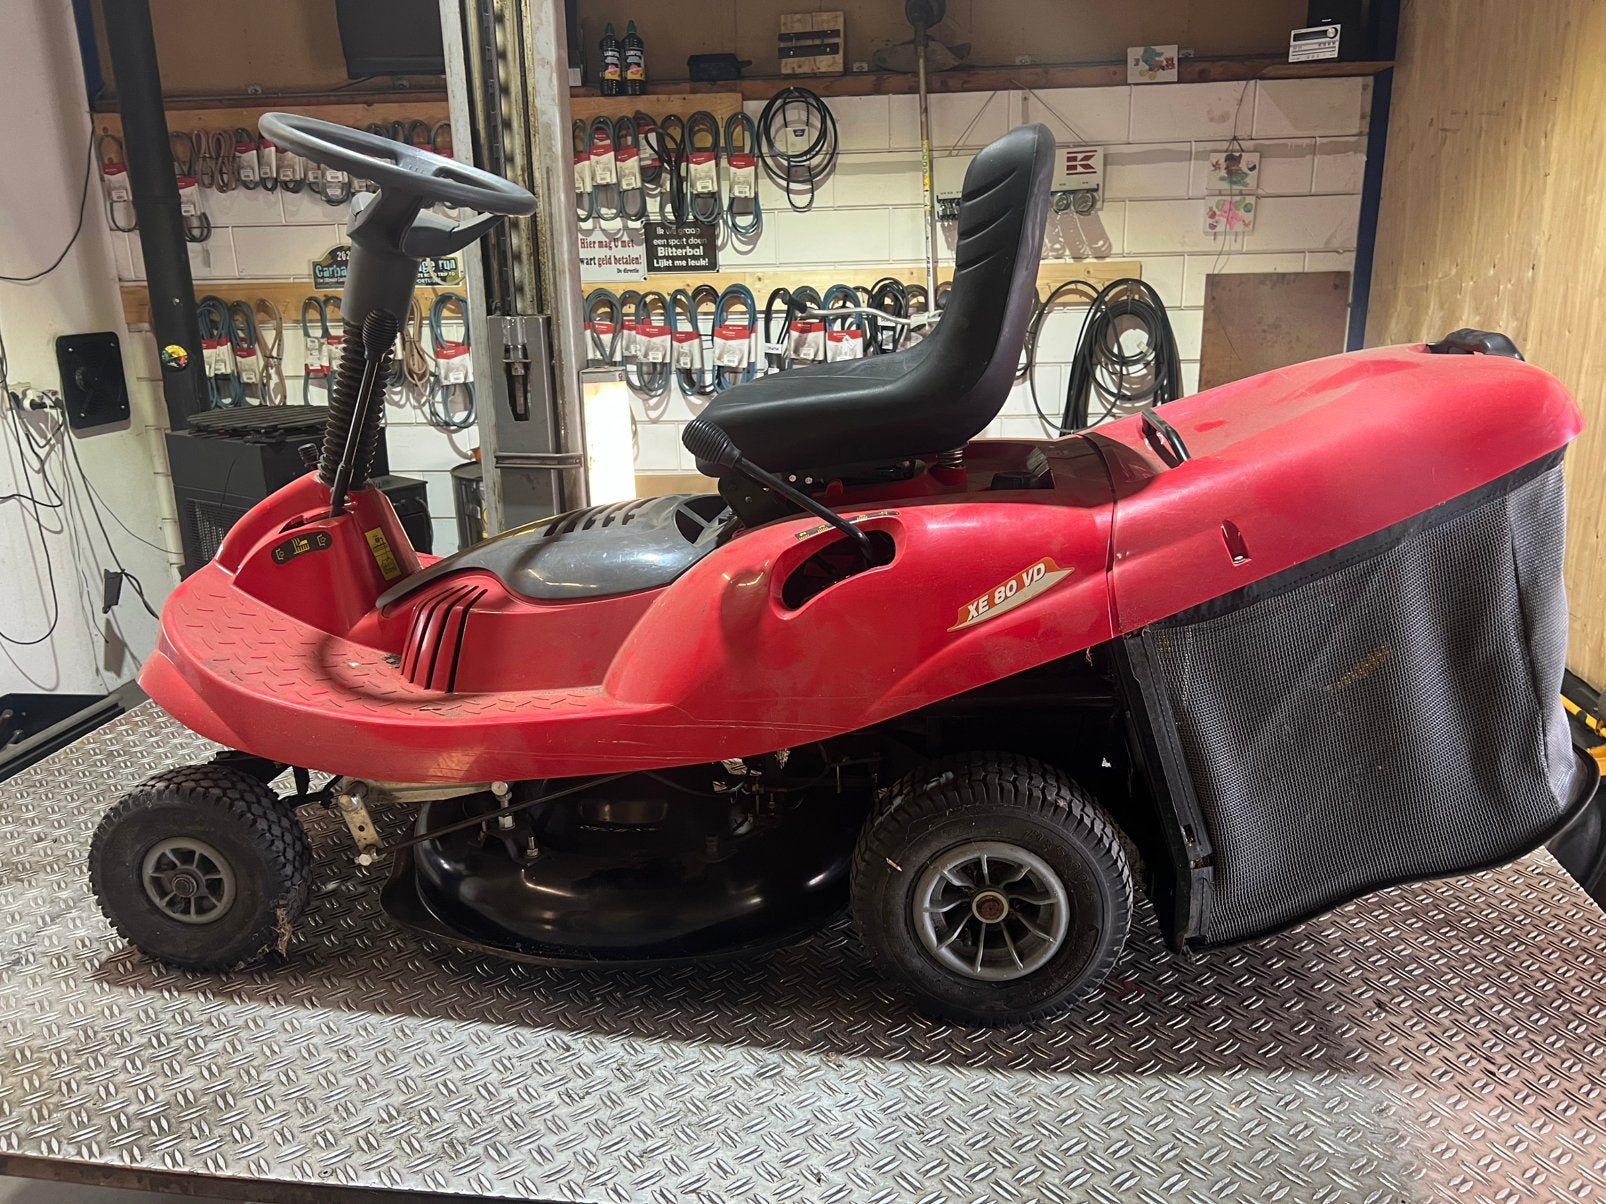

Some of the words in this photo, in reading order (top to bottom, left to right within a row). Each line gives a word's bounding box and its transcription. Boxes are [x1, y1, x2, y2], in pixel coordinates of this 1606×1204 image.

[656, 226, 664, 235] Ik
[580, 238, 596, 249] Hier
[597, 240, 613, 251] mag
[613, 238, 619, 248] U
[620, 239, 635, 248] met
[668, 237, 687, 246] sport
[688, 236, 708, 245] doen
[657, 246, 704, 257] Bitterbal
[438, 259, 456, 270] run
[579, 256, 597, 266] wart
[597, 254, 612, 268] geld
[613, 254, 642, 266] betalen!
[653, 258, 673, 268] Lijkt
[688, 257, 709, 267] leuk!
[966, 594, 989, 622] XE
[994, 579, 1018, 605] 80
[1022, 562, 1046, 587] VD
